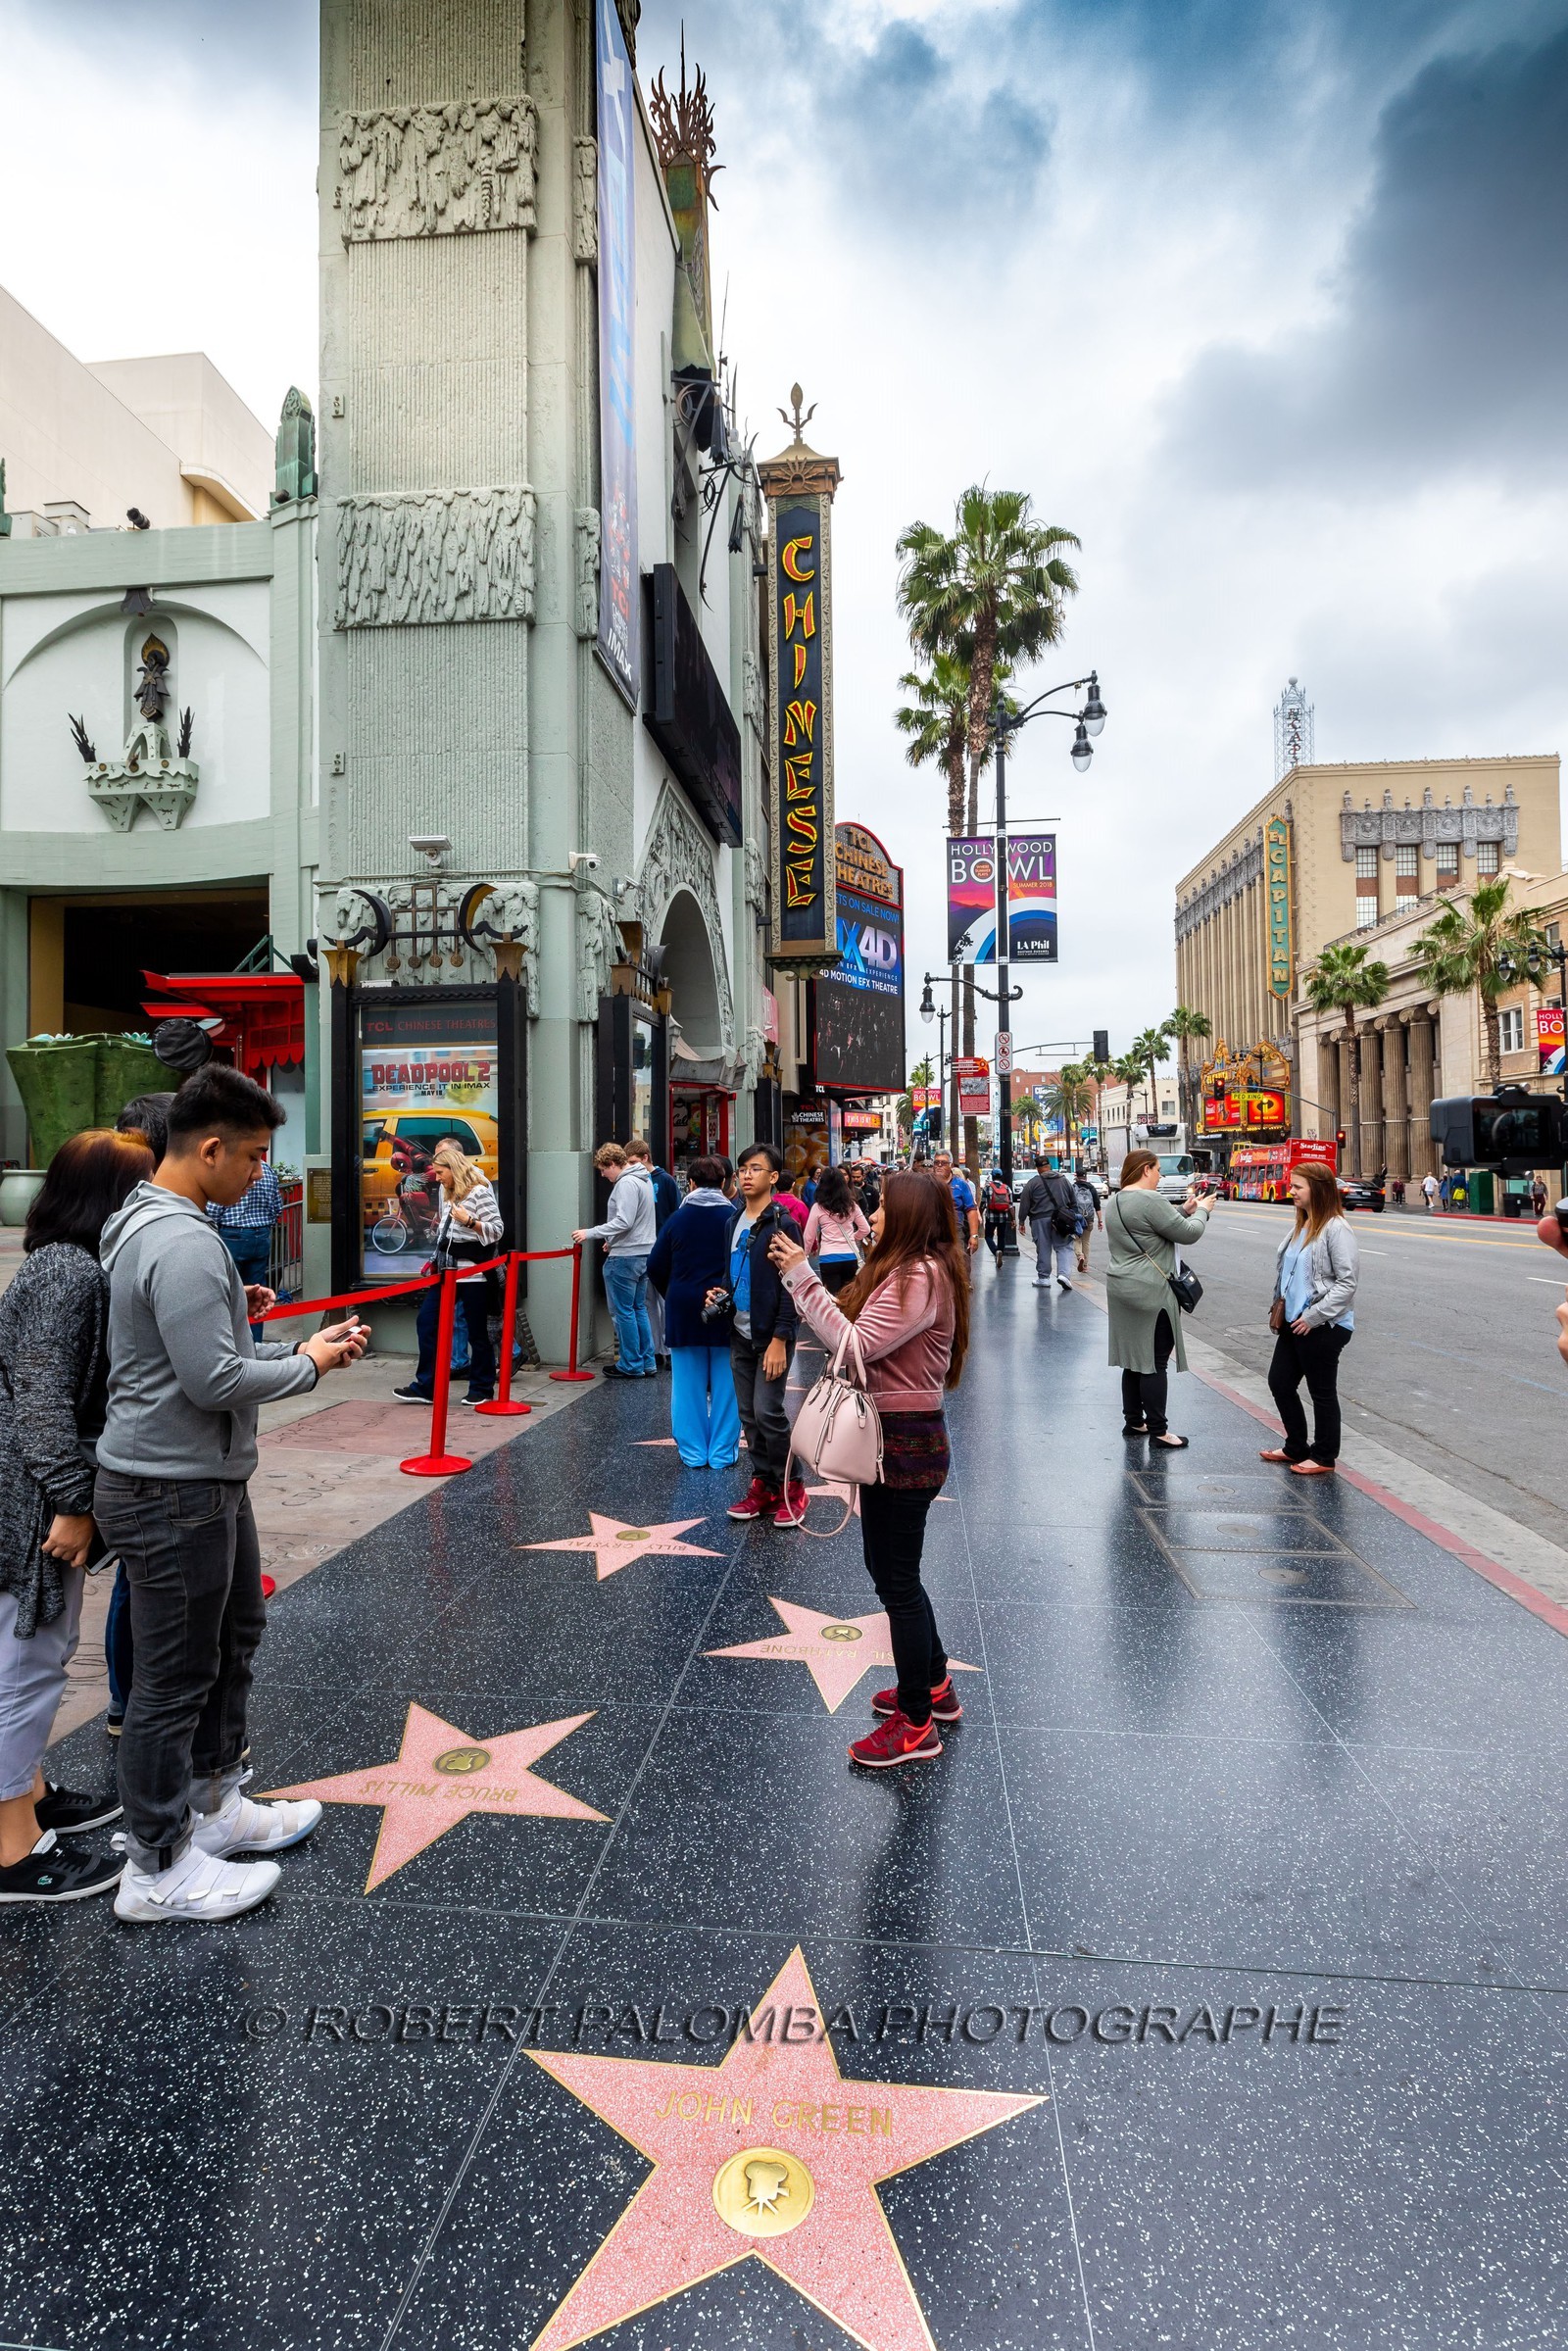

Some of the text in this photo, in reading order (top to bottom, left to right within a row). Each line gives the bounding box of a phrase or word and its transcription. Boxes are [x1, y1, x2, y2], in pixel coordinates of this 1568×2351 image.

[608, 627, 631, 681] IMAX
[782, 536, 817, 906] CHINESE
[846, 827, 872, 853] TCL
[1268, 829, 1287, 845] EL
[835, 842, 888, 878] CHINESE
[836, 862, 893, 900] HEATRES
[849, 898, 859, 910] ON
[861, 903, 879, 917] SALE
[880, 909, 900, 924] NOW!
[1270, 849, 1288, 982] CAPITAN
[1017, 940, 1050, 950] LA Phil
[819, 968, 898, 995] 4D MOTION EFX THEATRE
[865, 967, 898, 982] EXPERIENCE
[367, 1018, 496, 1032] TCL CHINESE THEATRES
[1540, 1020, 1564, 1034] BO
[371, 1061, 490, 1085] DEADPOOL 2
[567, 1541, 634, 1549] CRYSTAL
[760, 1643, 858, 1657] RATHBONE
[359, 1781, 518, 1802] BRUCE WILLIS
[655, 2090, 893, 2137] JOHN GREEN
